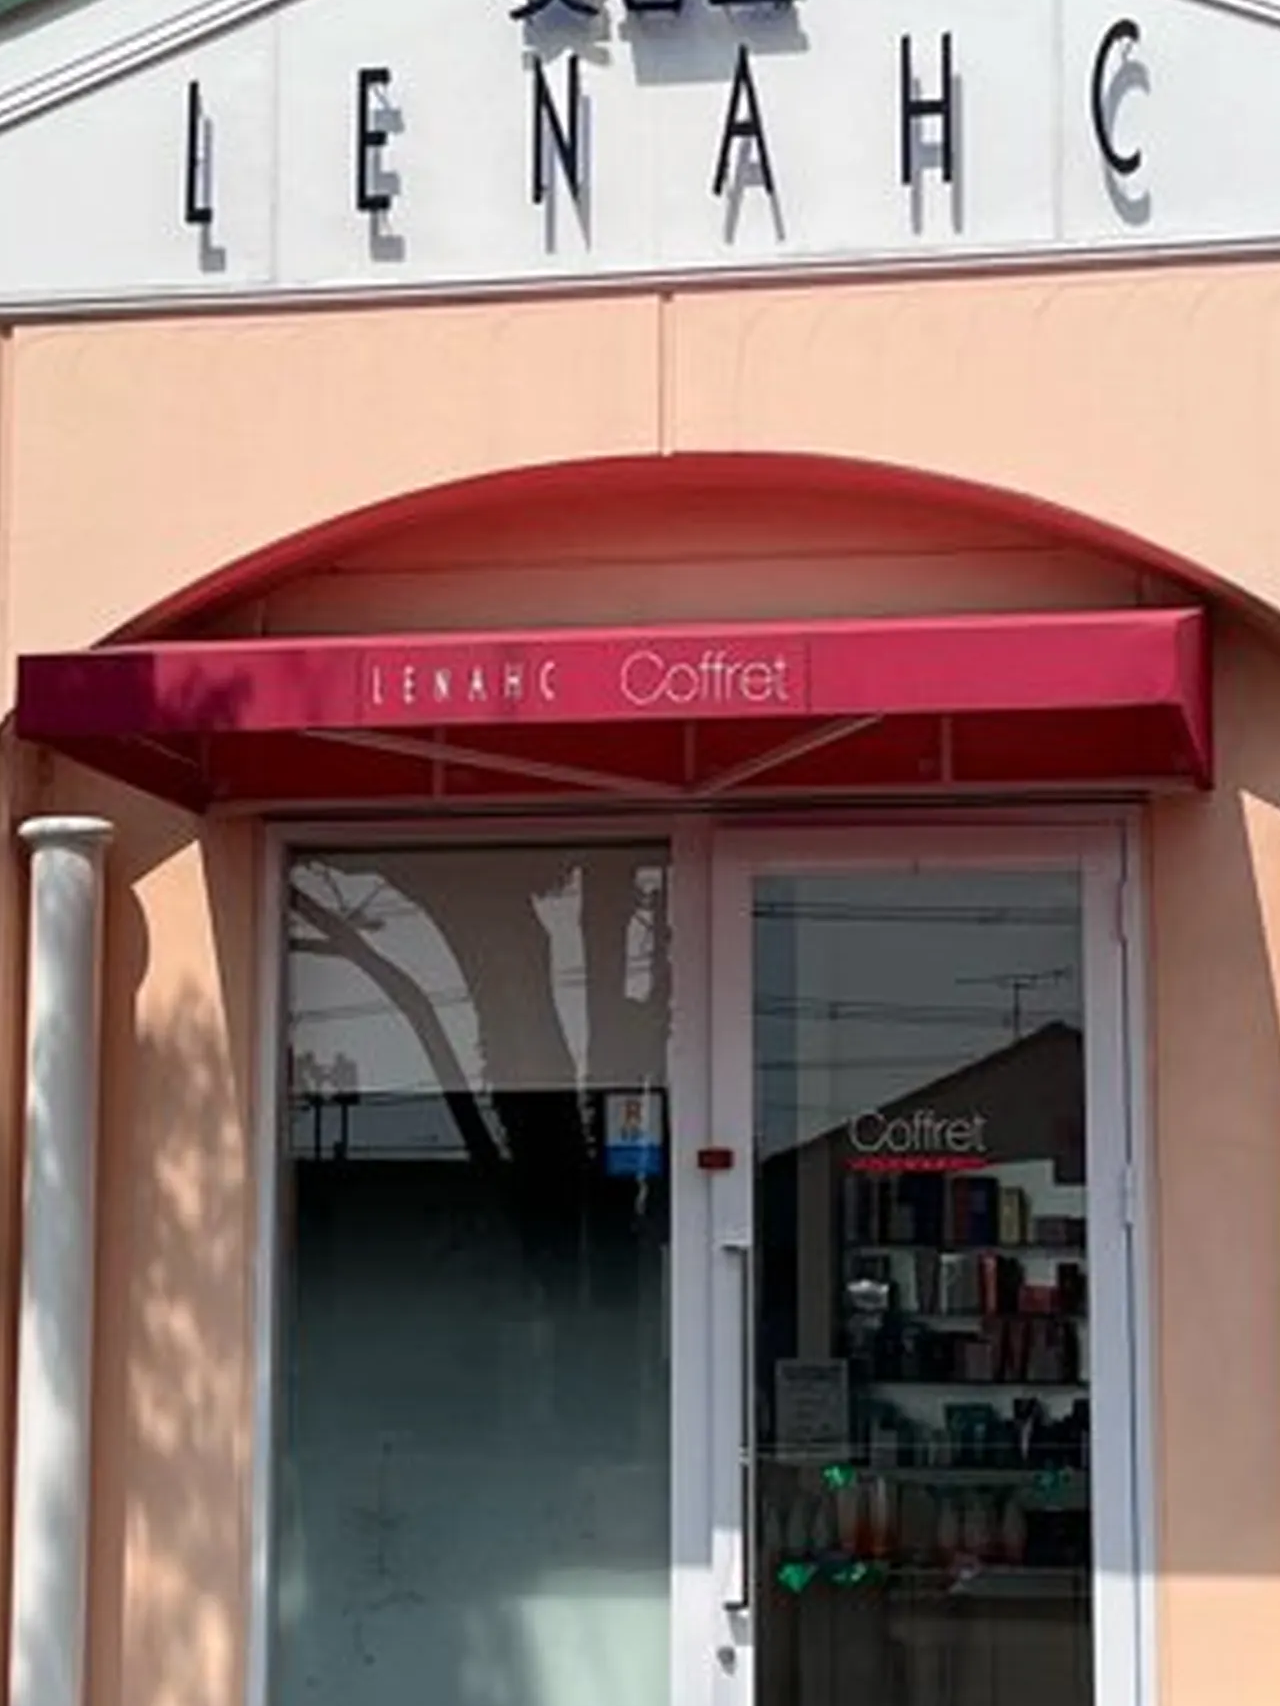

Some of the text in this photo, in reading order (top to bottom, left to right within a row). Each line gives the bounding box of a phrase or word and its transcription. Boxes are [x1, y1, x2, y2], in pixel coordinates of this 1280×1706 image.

[185, 17, 1143, 224] LENAHC
[372, 649, 789, 705] LENAHC Coffret
[848, 1107, 988, 1152] Coffret
